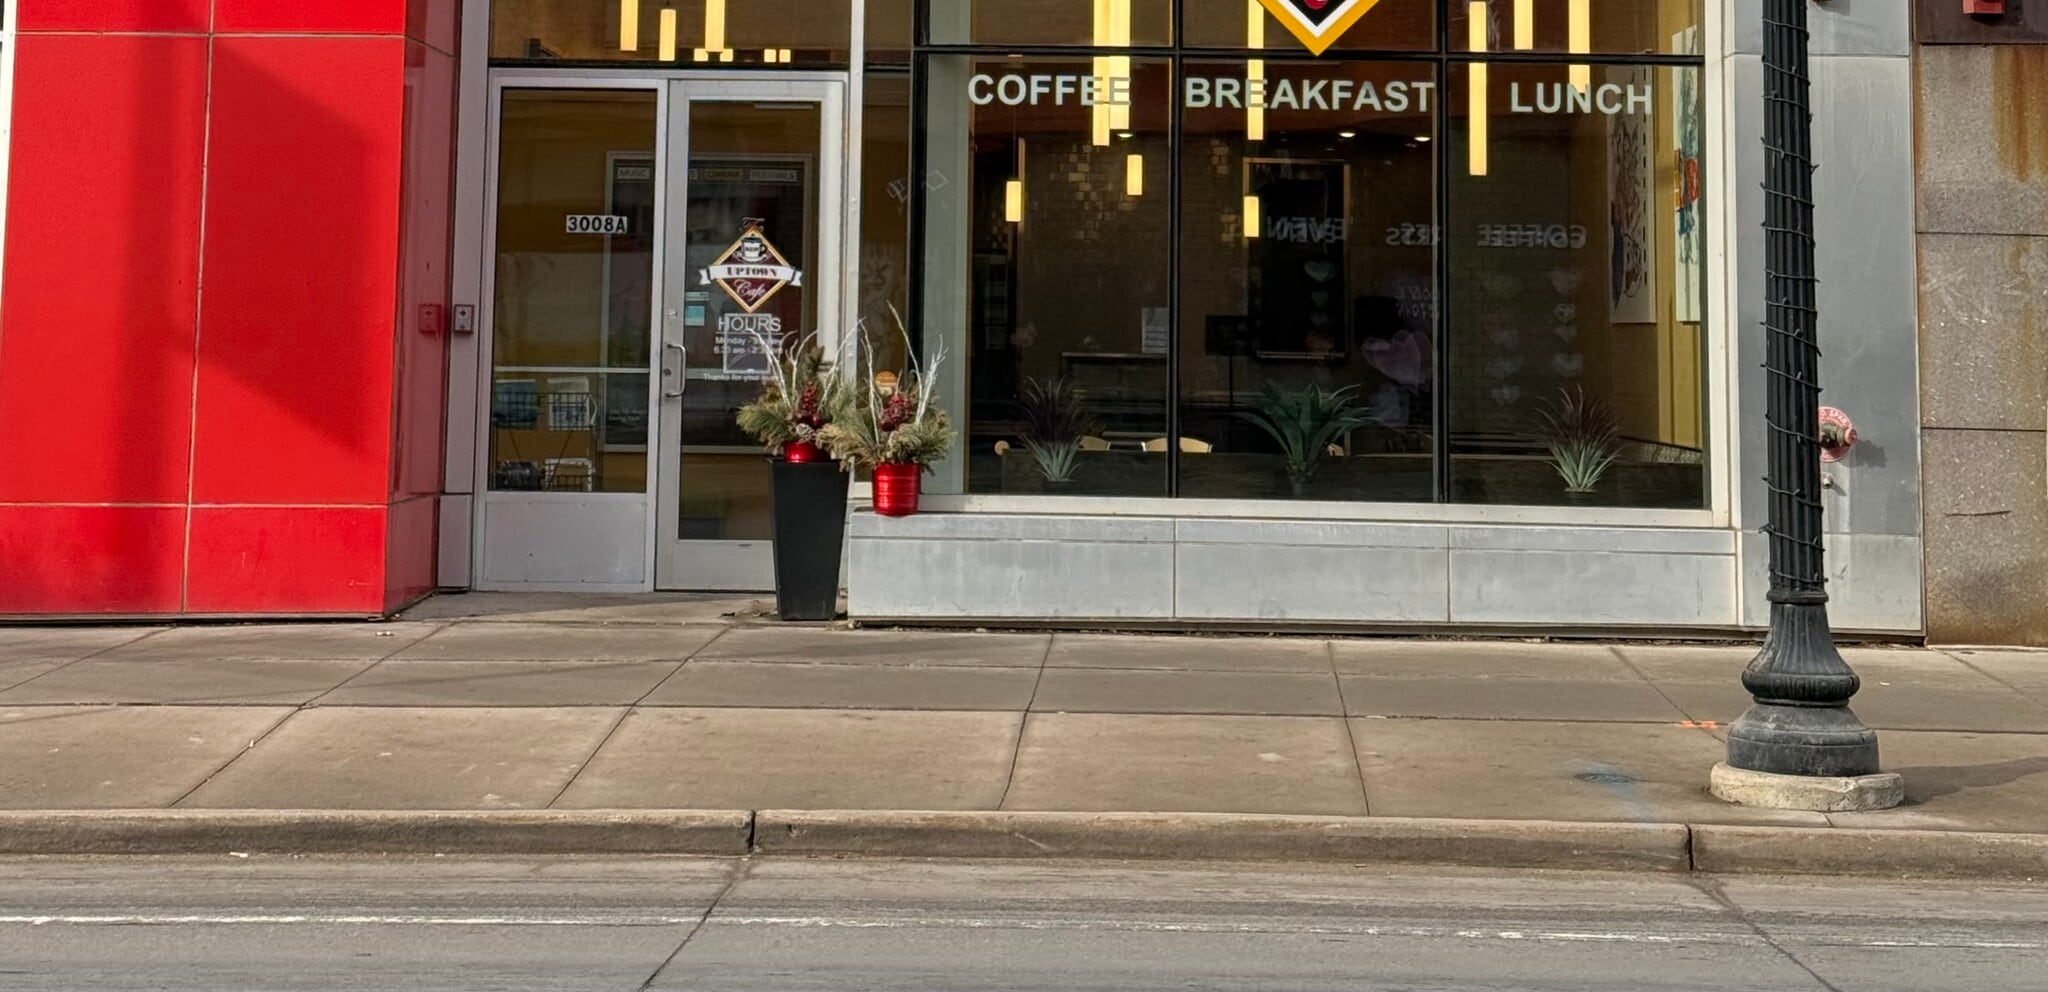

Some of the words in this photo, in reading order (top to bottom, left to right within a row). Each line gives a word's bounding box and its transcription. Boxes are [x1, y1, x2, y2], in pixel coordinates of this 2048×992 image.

[967, 74, 1131, 106] COFFEE
[1185, 77, 1435, 112] BREAKFAST
[1511, 82, 1651, 115] LUNCH
[568, 216, 626, 232] 3008A
[727, 266, 778, 277] UPTOWN
[718, 316, 782, 332] HOURS
